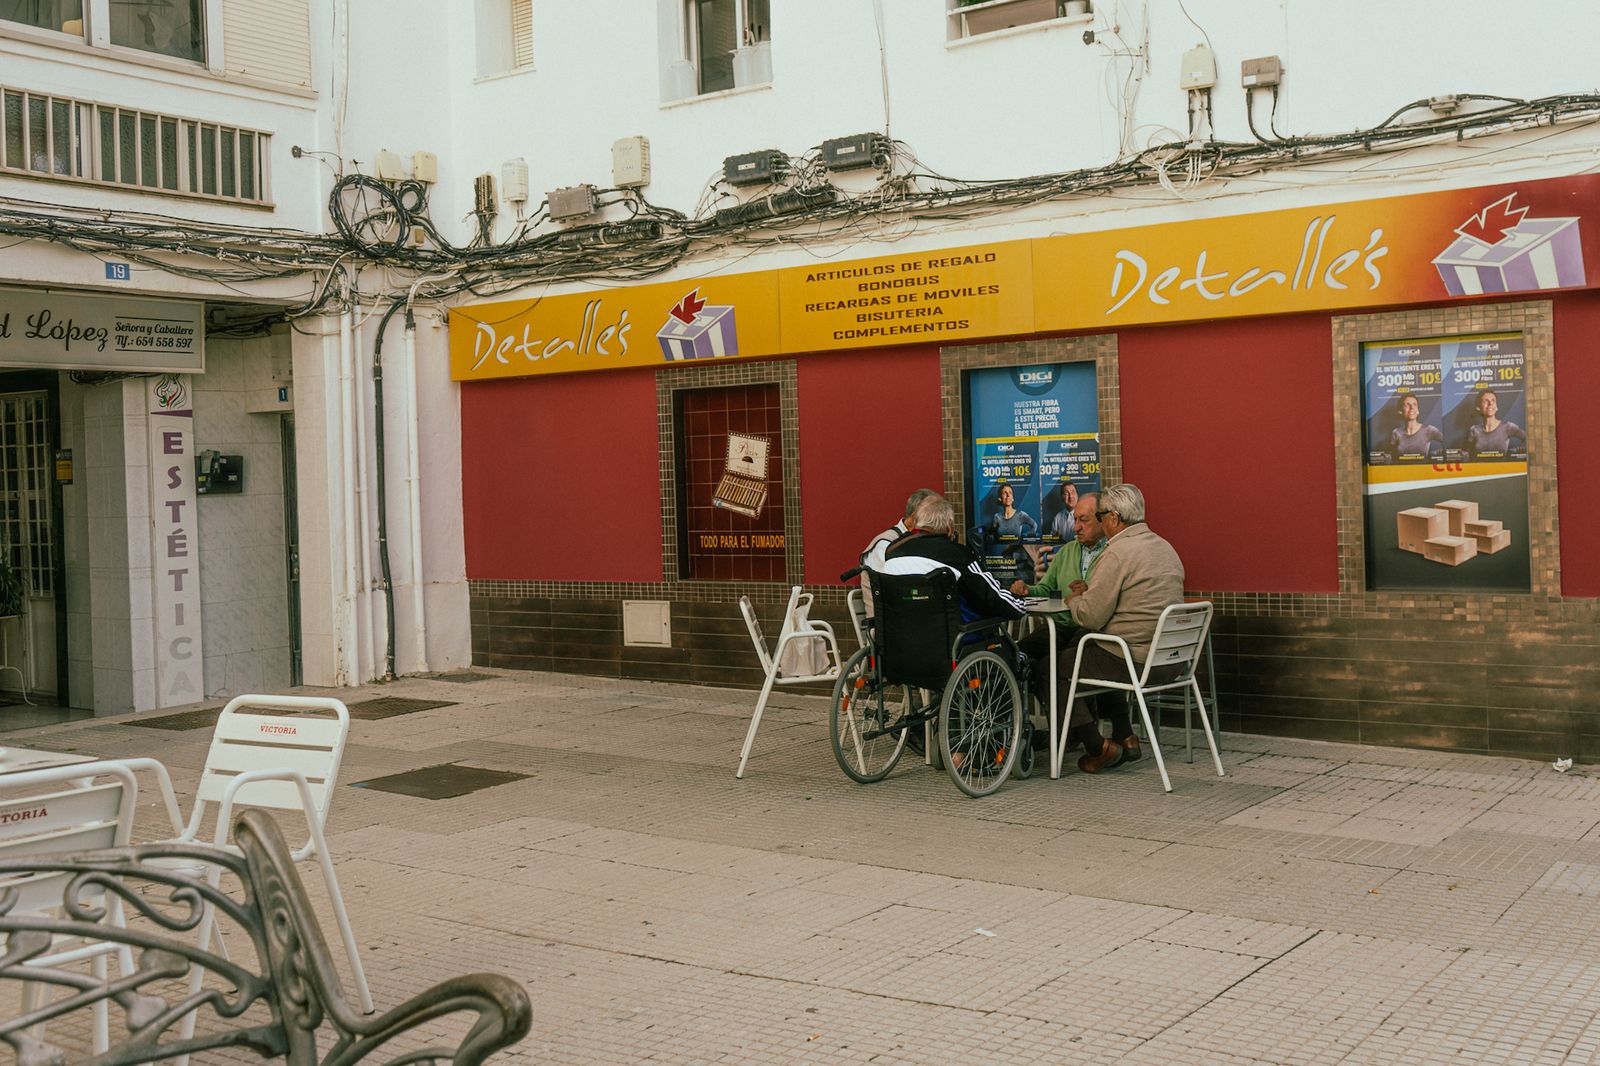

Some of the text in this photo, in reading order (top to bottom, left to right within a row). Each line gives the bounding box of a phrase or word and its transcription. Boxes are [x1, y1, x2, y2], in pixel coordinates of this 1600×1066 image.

[111, 264, 125, 279] 19
[805, 252, 997, 283] ARTICULOS DE REGALO
[857, 275, 940, 292] BONOBUS
[805, 284, 1000, 313] RECARGAS DE MOVILES
[856, 306, 944, 323] BISUTERIA
[25, 309, 108, 352] López
[115, 322, 194, 336] Señora y Caballero
[833, 319, 969, 340] COMPLEMENTOS
[135, 336, 154, 347] 654
[155, 337, 174, 348] 558
[175, 338, 193, 348] 597
[1019, 371, 1052, 381] DIGI
[1377, 374, 1402, 387] 300
[1454, 367, 1521, 382] 300 Mb 10€
[1014, 399, 1059, 408] NUESTRA FIBRA
[1044, 406, 1060, 414] PERO
[1022, 421, 1059, 429] INTELIGENTE
[982, 466, 1001, 477] 300
[1039, 464, 1052, 475] 30
[700, 535, 785, 548] TODO PARA EL FUMADOR
[162, 431, 197, 697] ESTÉTICA
[260, 725, 297, 735] VICTORIA
[0, 808, 48, 823] TORIA
